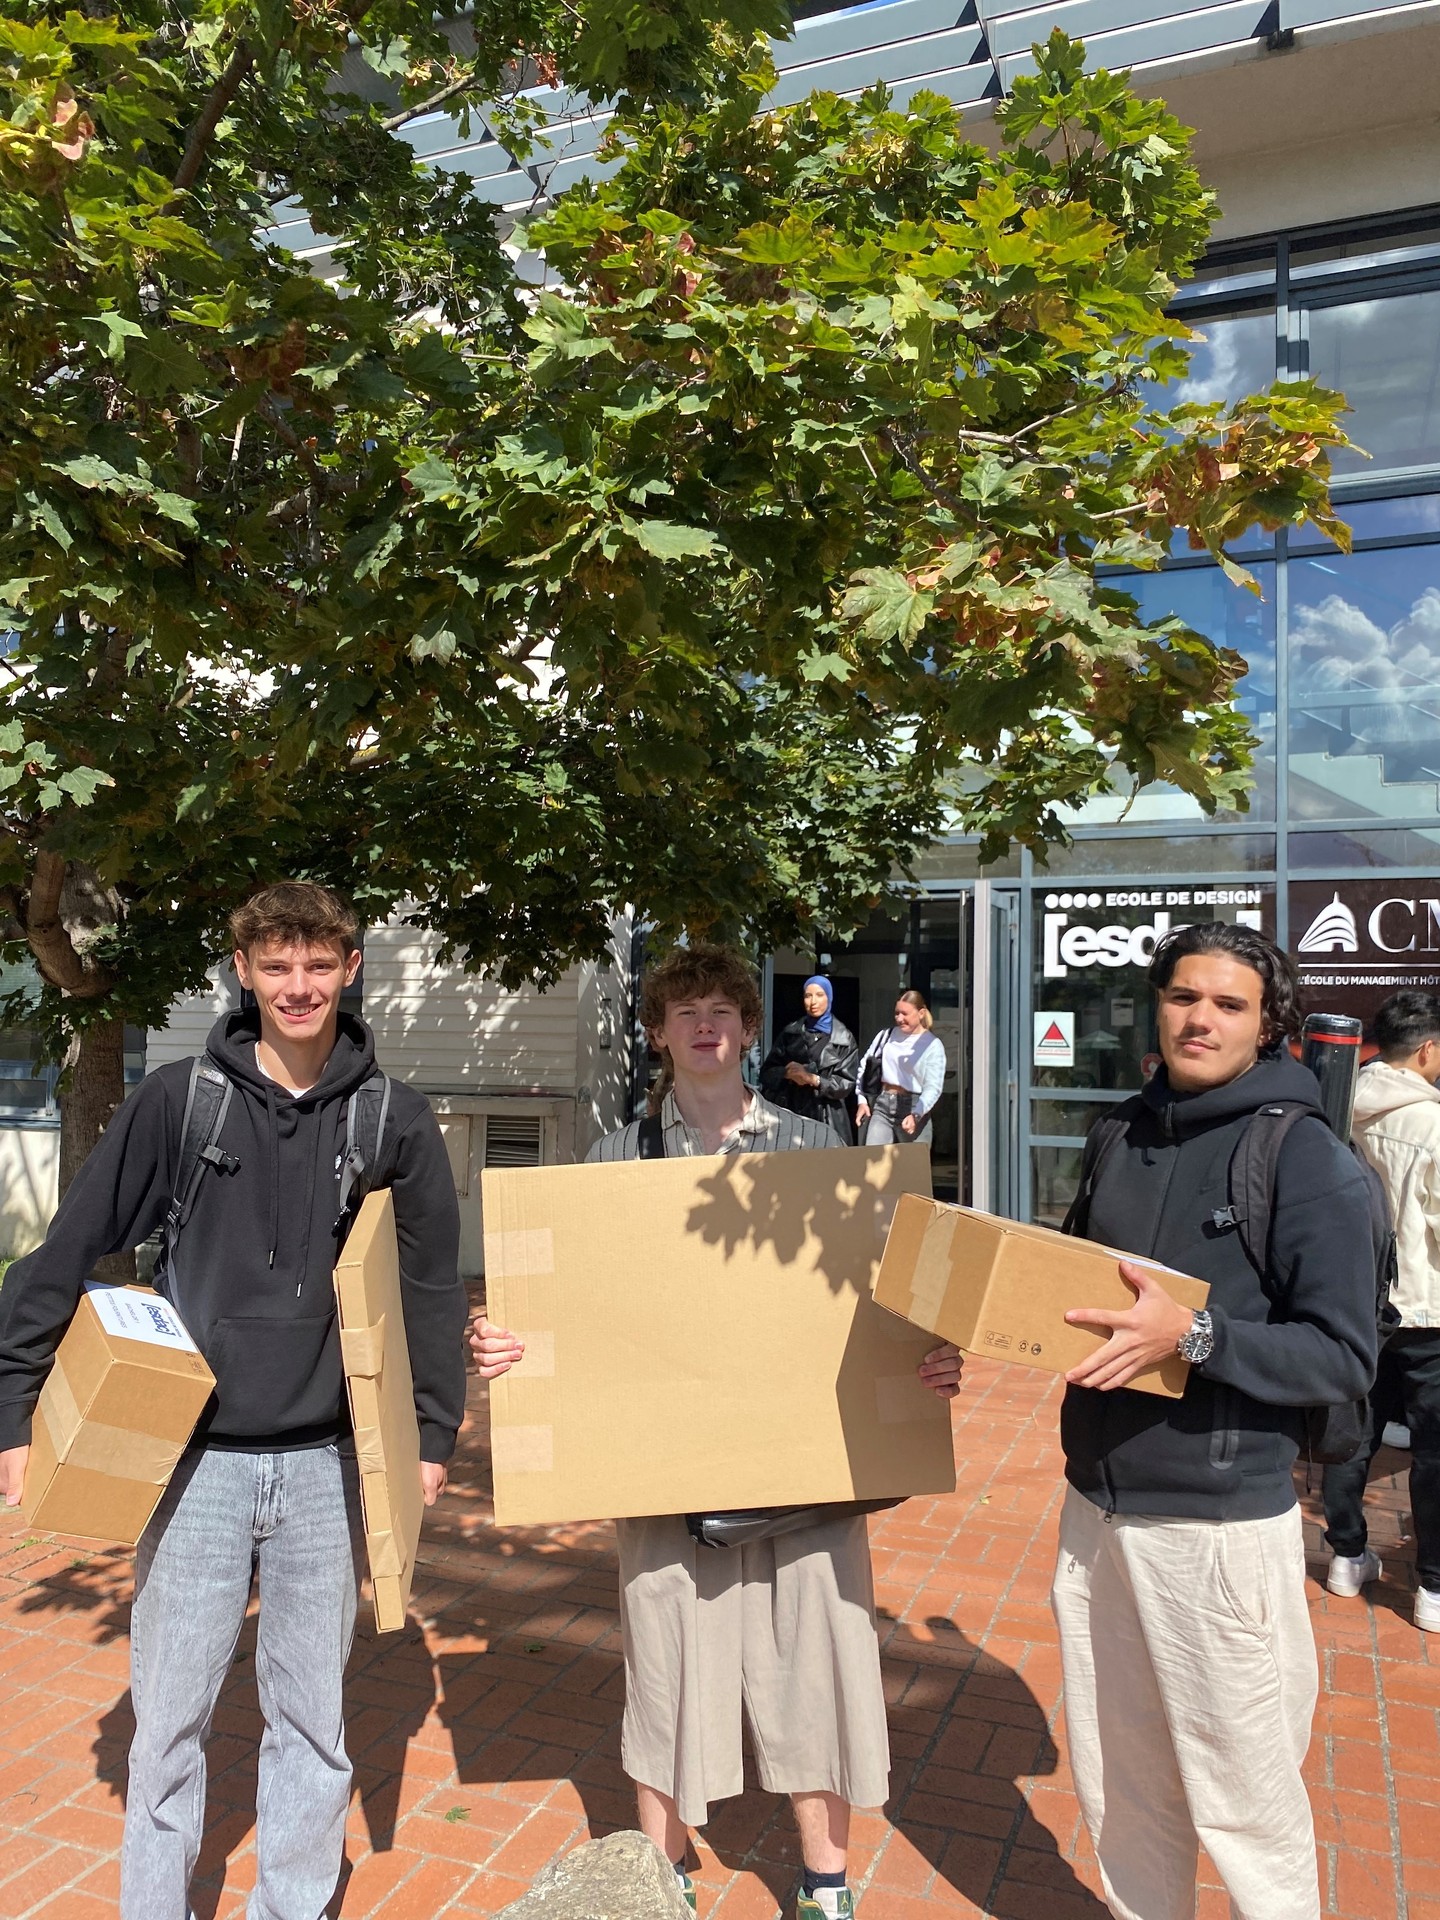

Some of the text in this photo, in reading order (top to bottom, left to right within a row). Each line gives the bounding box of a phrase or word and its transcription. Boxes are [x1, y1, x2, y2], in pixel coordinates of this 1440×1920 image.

[1106, 890, 1261, 907] ECOLE DE DESIGN
[1335, 975, 1349, 986] DU
[1350, 975, 1418, 986] MANAGEMENT
